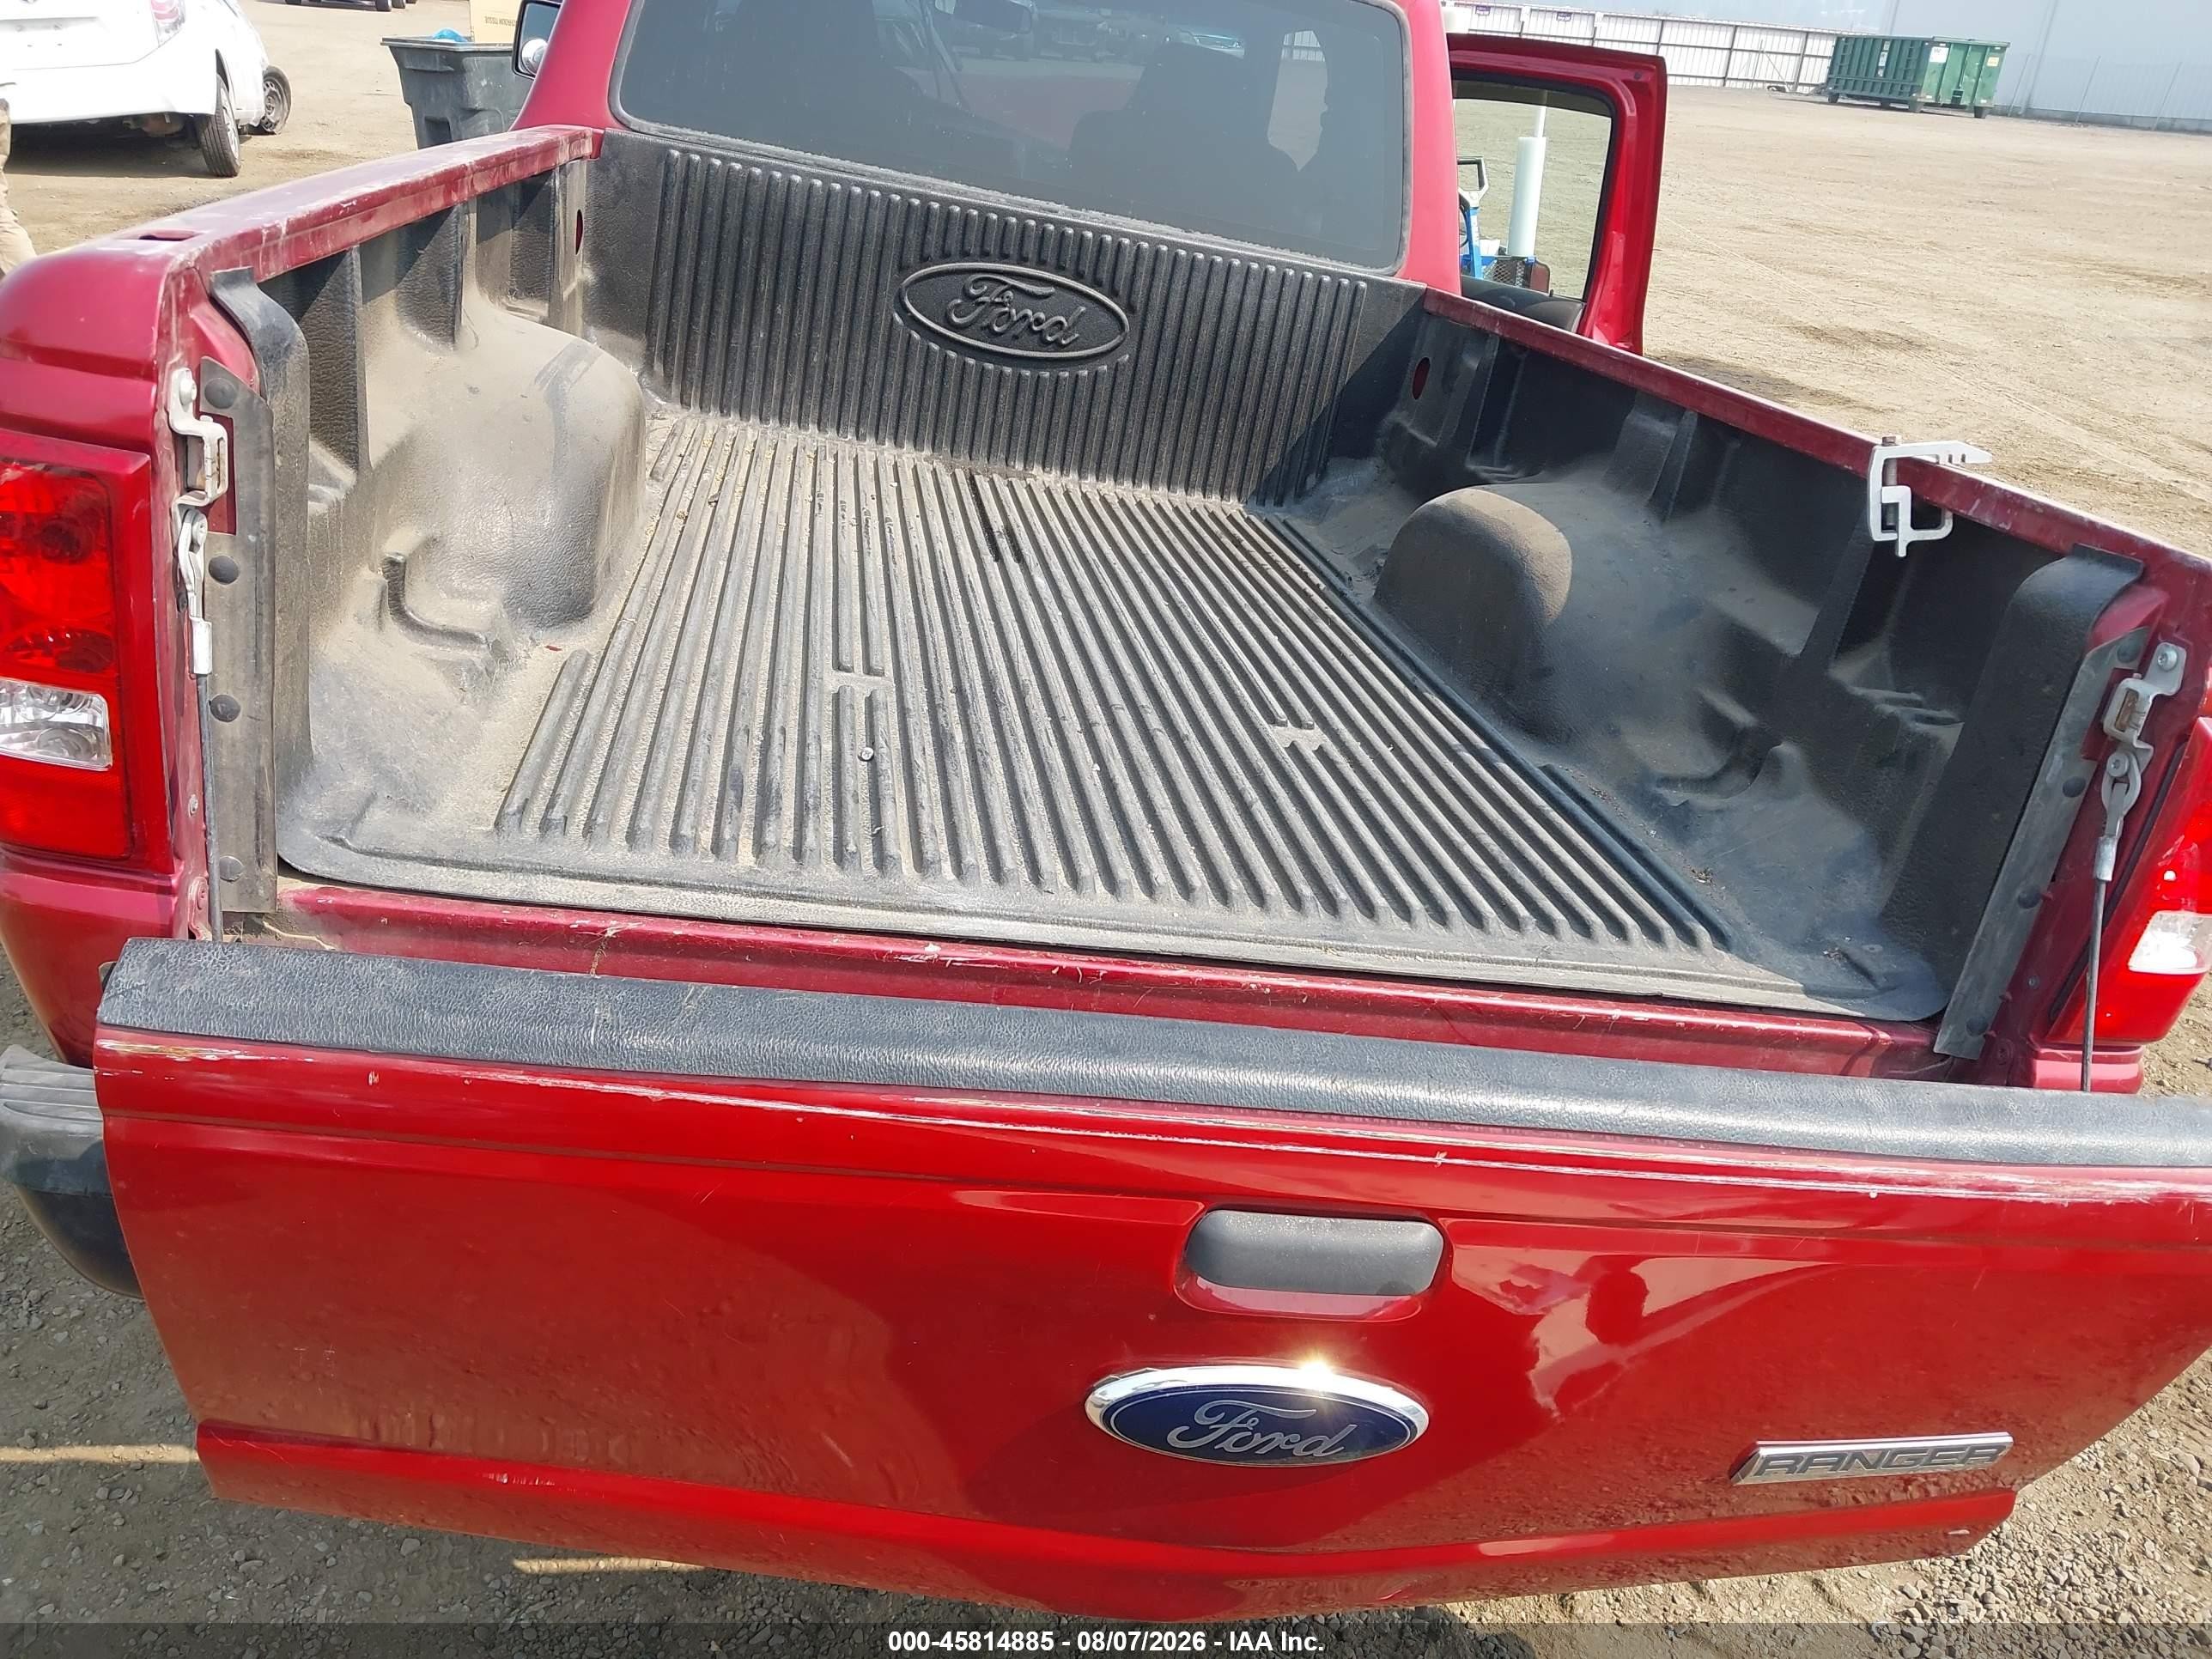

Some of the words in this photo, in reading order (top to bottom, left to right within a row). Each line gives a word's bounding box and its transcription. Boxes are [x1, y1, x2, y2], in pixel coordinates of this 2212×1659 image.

[947, 273, 1086, 345] Ford
[1166, 1399, 1358, 1457] Ford
[1753, 1444, 2008, 1477] RANGER
